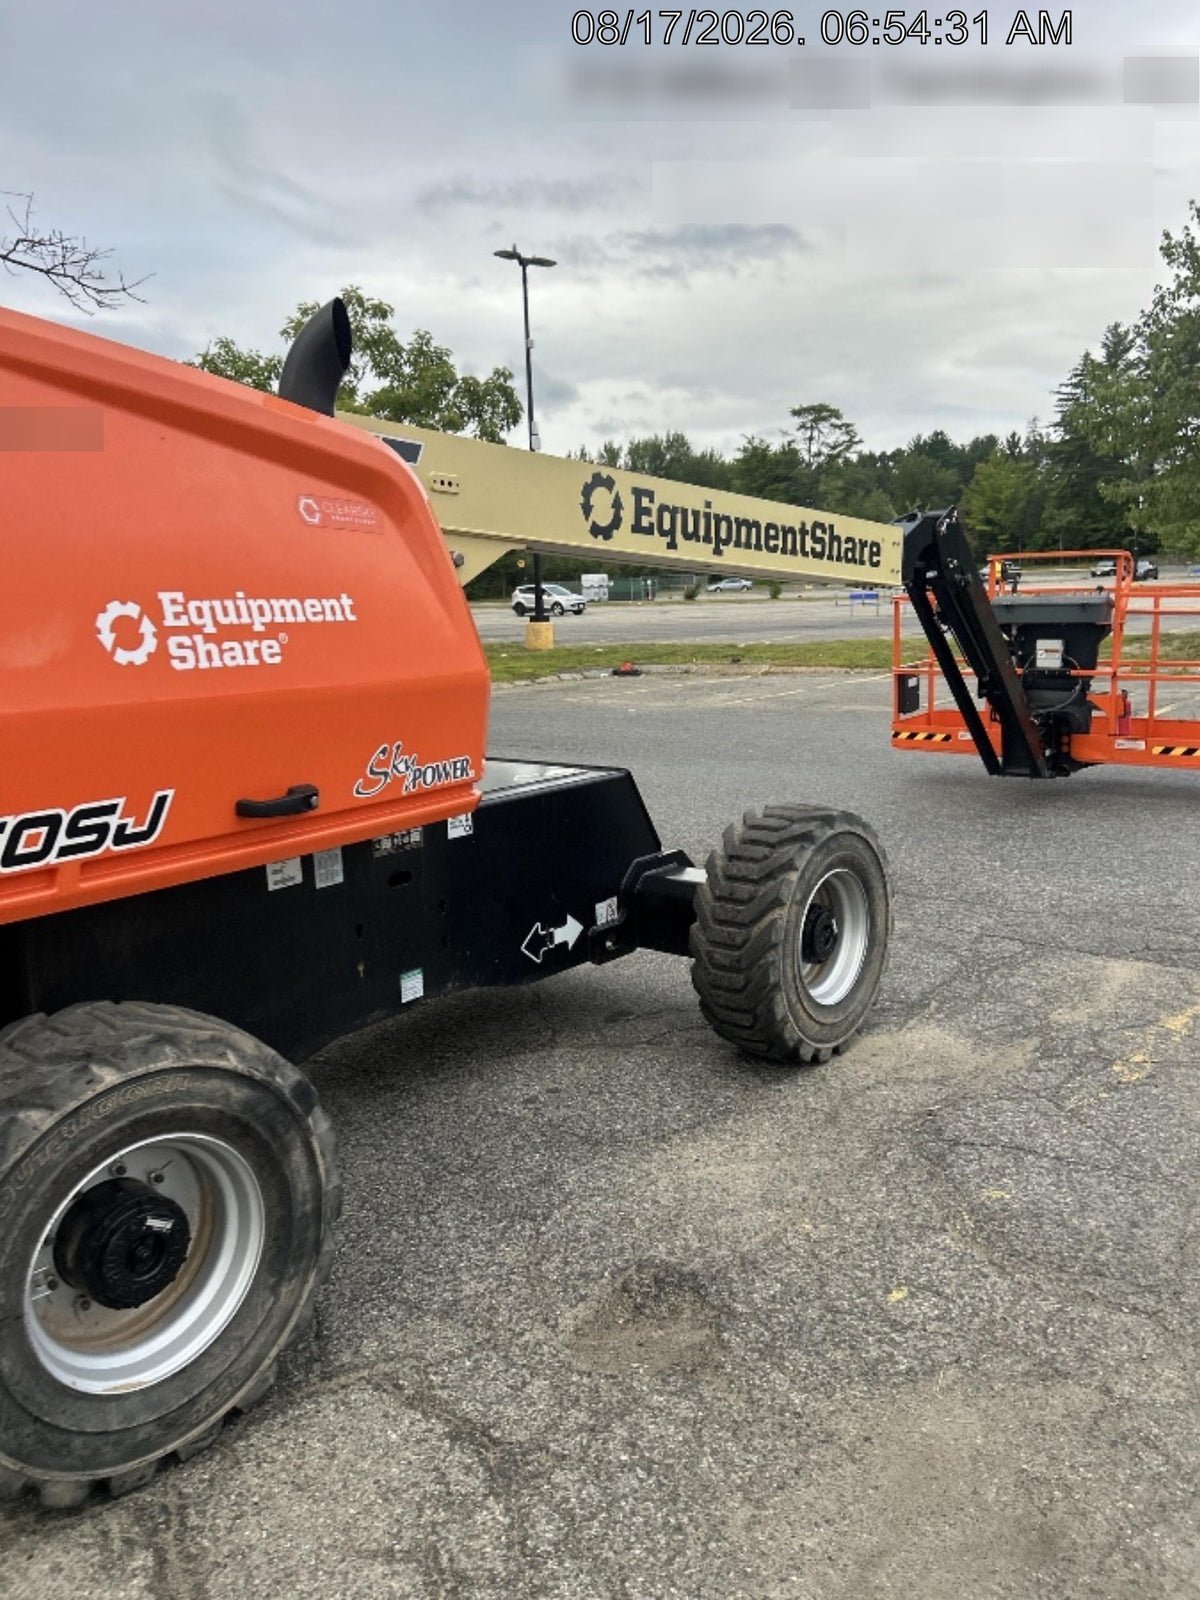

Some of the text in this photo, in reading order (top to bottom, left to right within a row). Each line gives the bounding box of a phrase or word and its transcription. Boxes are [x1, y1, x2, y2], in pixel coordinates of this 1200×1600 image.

[631, 486, 881, 568] EquipmentShare
[157, 591, 357, 633] Equipment
[353, 741, 471, 797] Sky POWER
[0, 788, 176, 874] 0SJ
